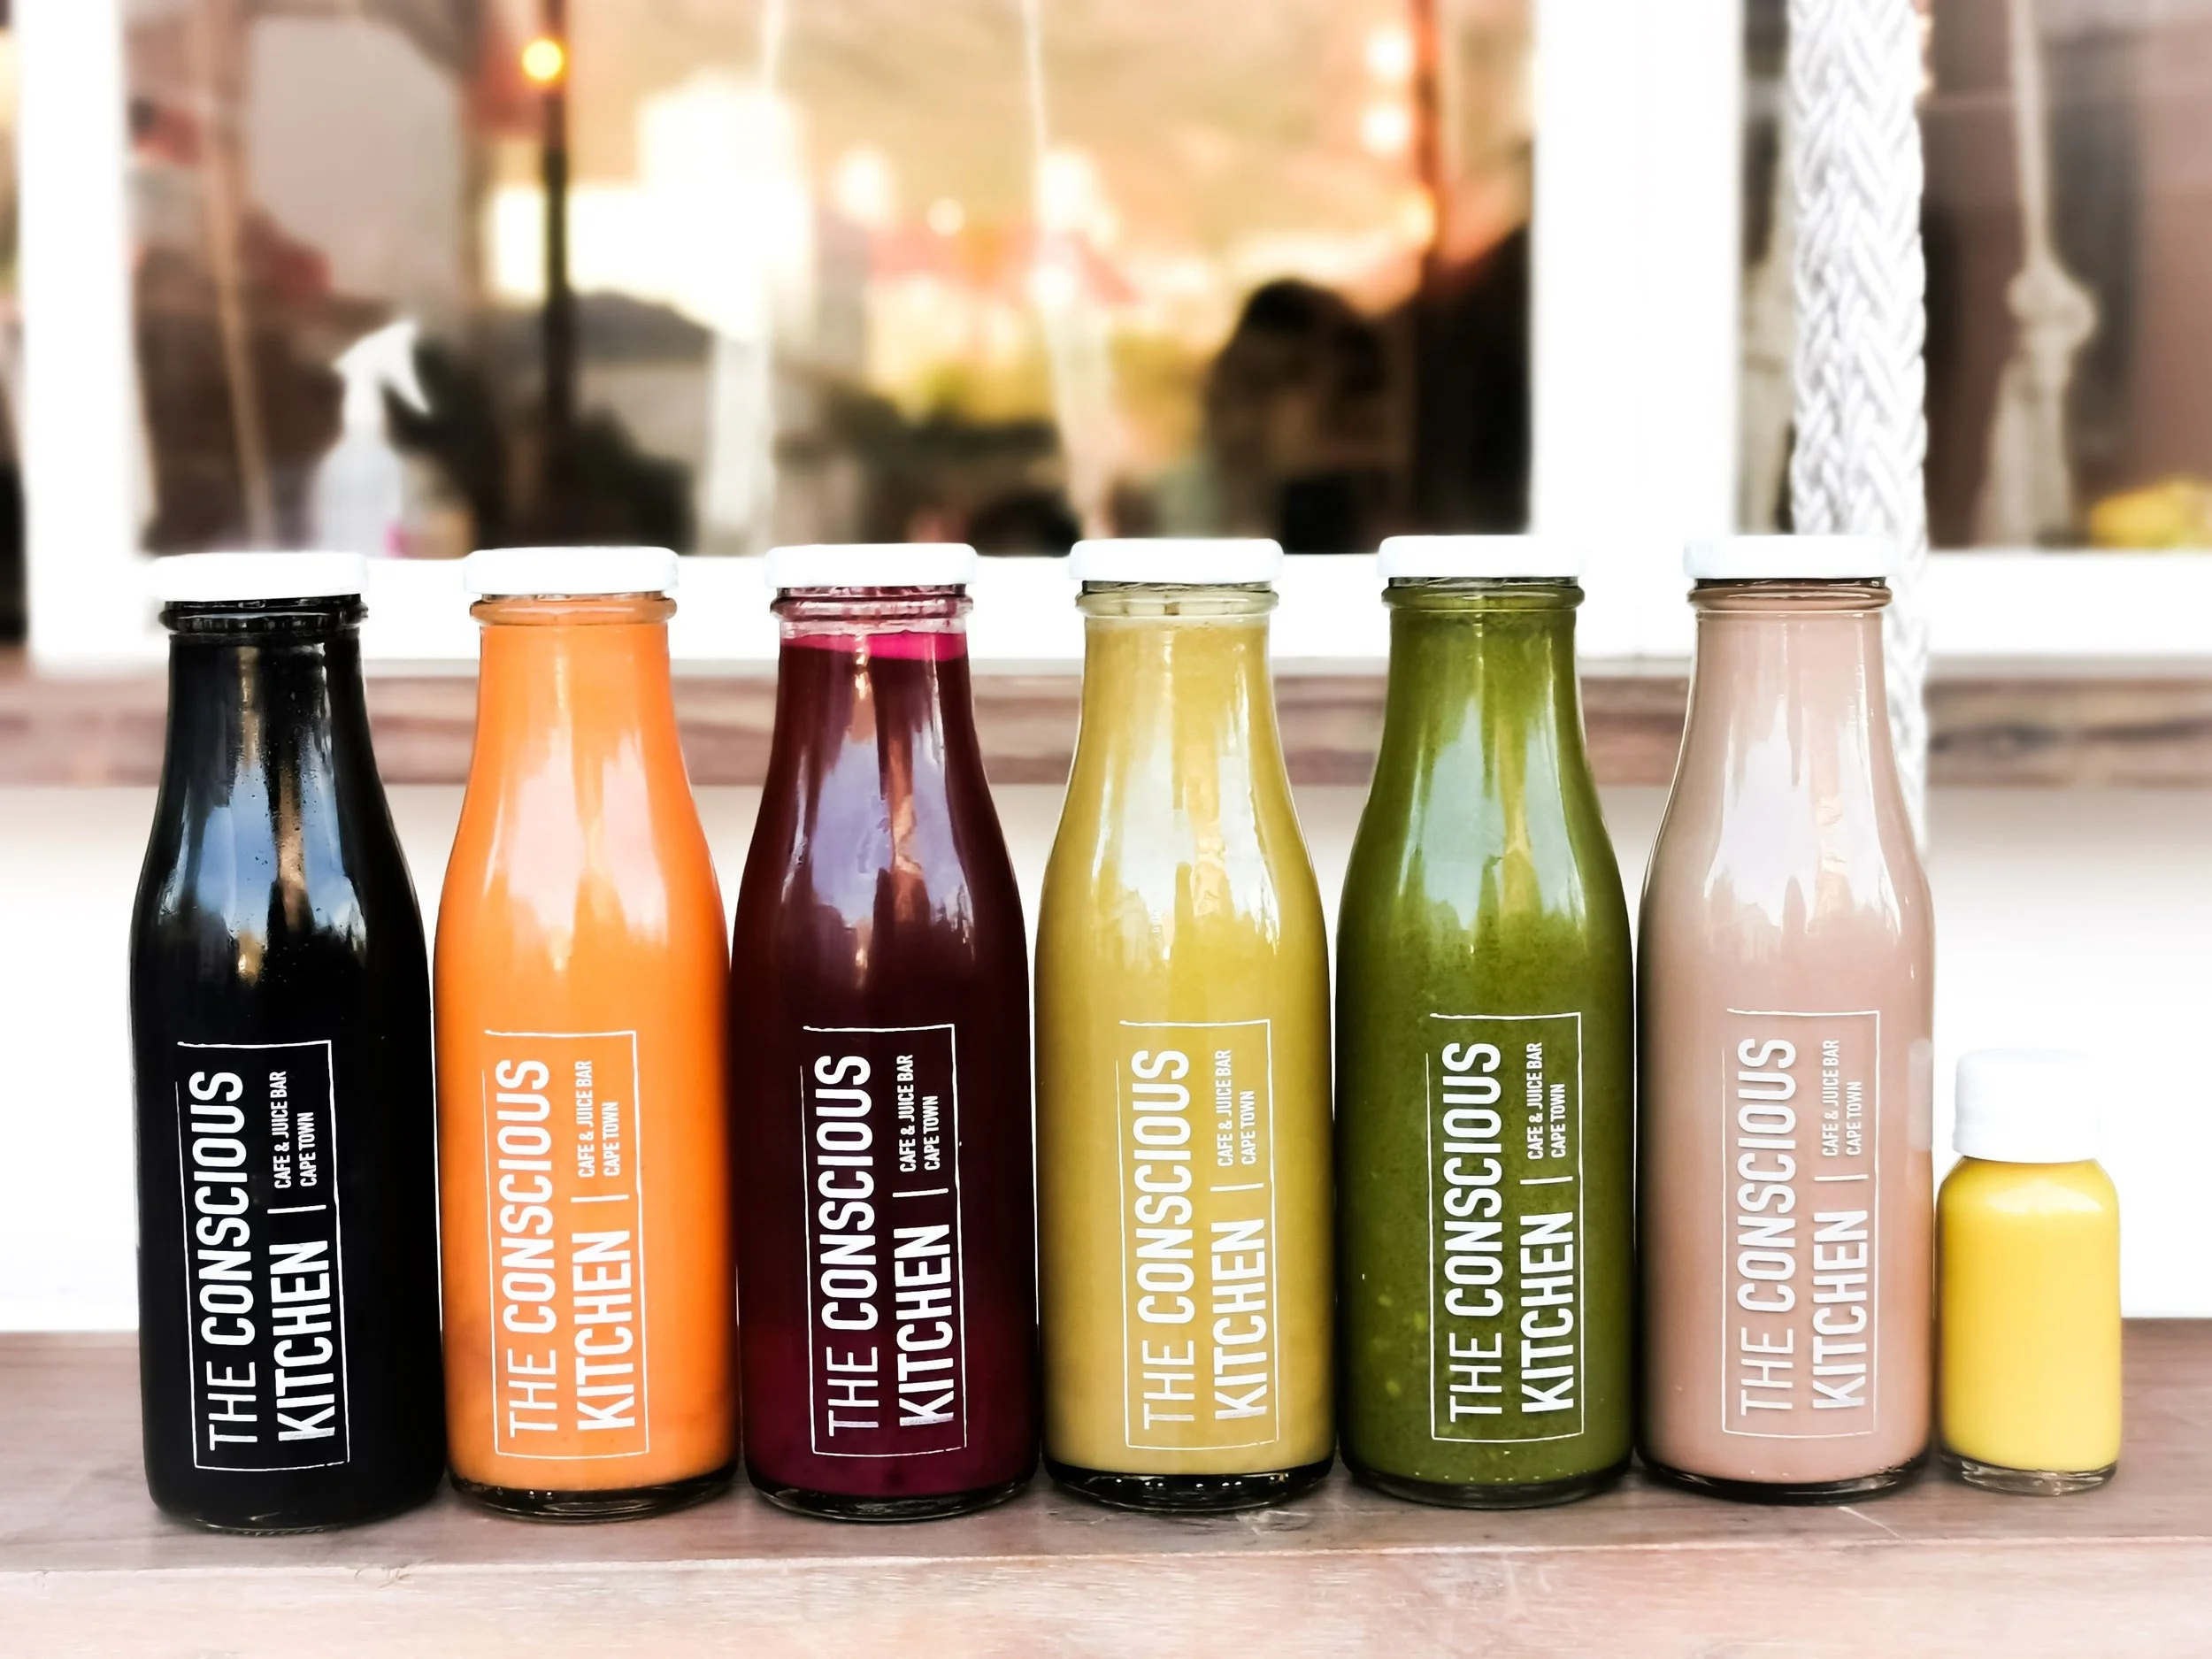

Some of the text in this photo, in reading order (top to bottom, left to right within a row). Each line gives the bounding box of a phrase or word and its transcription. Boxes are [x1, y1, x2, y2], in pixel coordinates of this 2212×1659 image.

[270, 1071, 291, 1188] CAFE & JUICE BAR
[297, 1112, 317, 1187] CAPE TOWN
[575, 1061, 595, 1177] CAFE & JUICE BAR
[602, 1102, 620, 1177] CAPE TOWN
[896, 1055, 916, 1171] CAFE & JUICE BAR
[922, 1096, 940, 1170] CAPE TOWN
[1215, 1049, 1233, 1166] CAFE & JUICE BAR
[1240, 1091, 1256, 1164] CAPE TOWN
[1526, 1042, 1543, 1159] CAFE & JUICE BAR
[1550, 1084, 1565, 1157] CAPE TOWN
[1823, 1041, 1839, 1156] CAFE & JUICE BAR
[1846, 1081, 1862, 1156] CAPE TOWN
[189, 1071, 258, 1451] THE CONSCIOUS
[495, 1060, 558, 1438] THE CONSCIOUS
[814, 1055, 879, 1437] THE CONSCIOUS
[1131, 1049, 1194, 1430] THE CONSCIOUS
[1442, 1042, 1502, 1422] THE CONSCIOUS
[1737, 1039, 1796, 1416] THE CONSCIOUS
[269, 1240, 335, 1441] KITCHEN
[572, 1230, 635, 1430] KITCHEN
[894, 1225, 955, 1426] KITCHEN
[1210, 1218, 1267, 1420] KITCHEN
[1520, 1211, 1574, 1413] KITCHEN
[1812, 1210, 1869, 1409] KITCHEN
